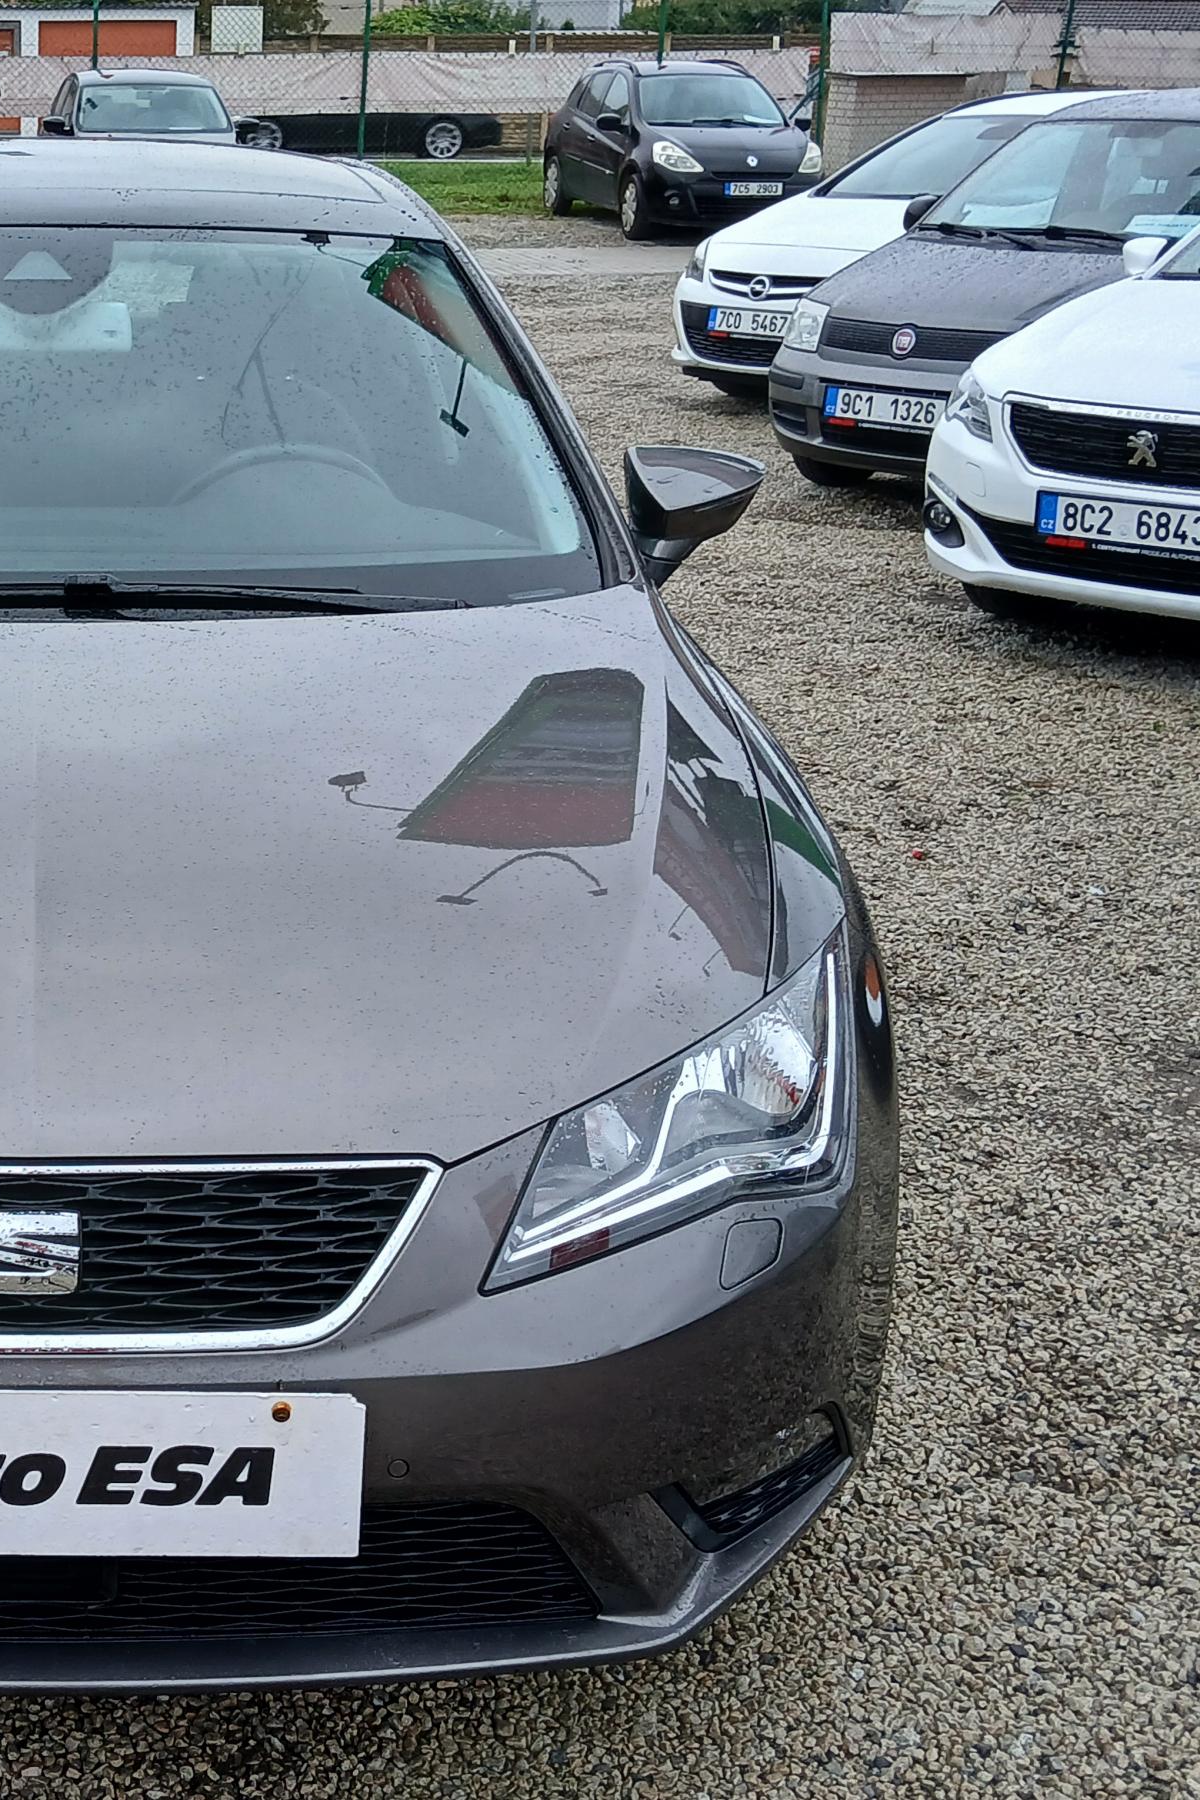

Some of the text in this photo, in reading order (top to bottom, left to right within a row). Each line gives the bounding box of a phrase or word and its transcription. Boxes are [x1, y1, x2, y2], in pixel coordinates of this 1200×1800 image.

[732, 184, 750, 194] 7C5
[718, 311, 789, 334] 7C0 5467
[840, 392, 874, 417] 9C1
[890, 398, 937, 424] 1326
[1116, 409, 1180, 421] PEUGEOT
[1040, 518, 1055, 529] CZ
[1062, 502, 1114, 536] 8C2
[75, 1445, 276, 1506] ESA
